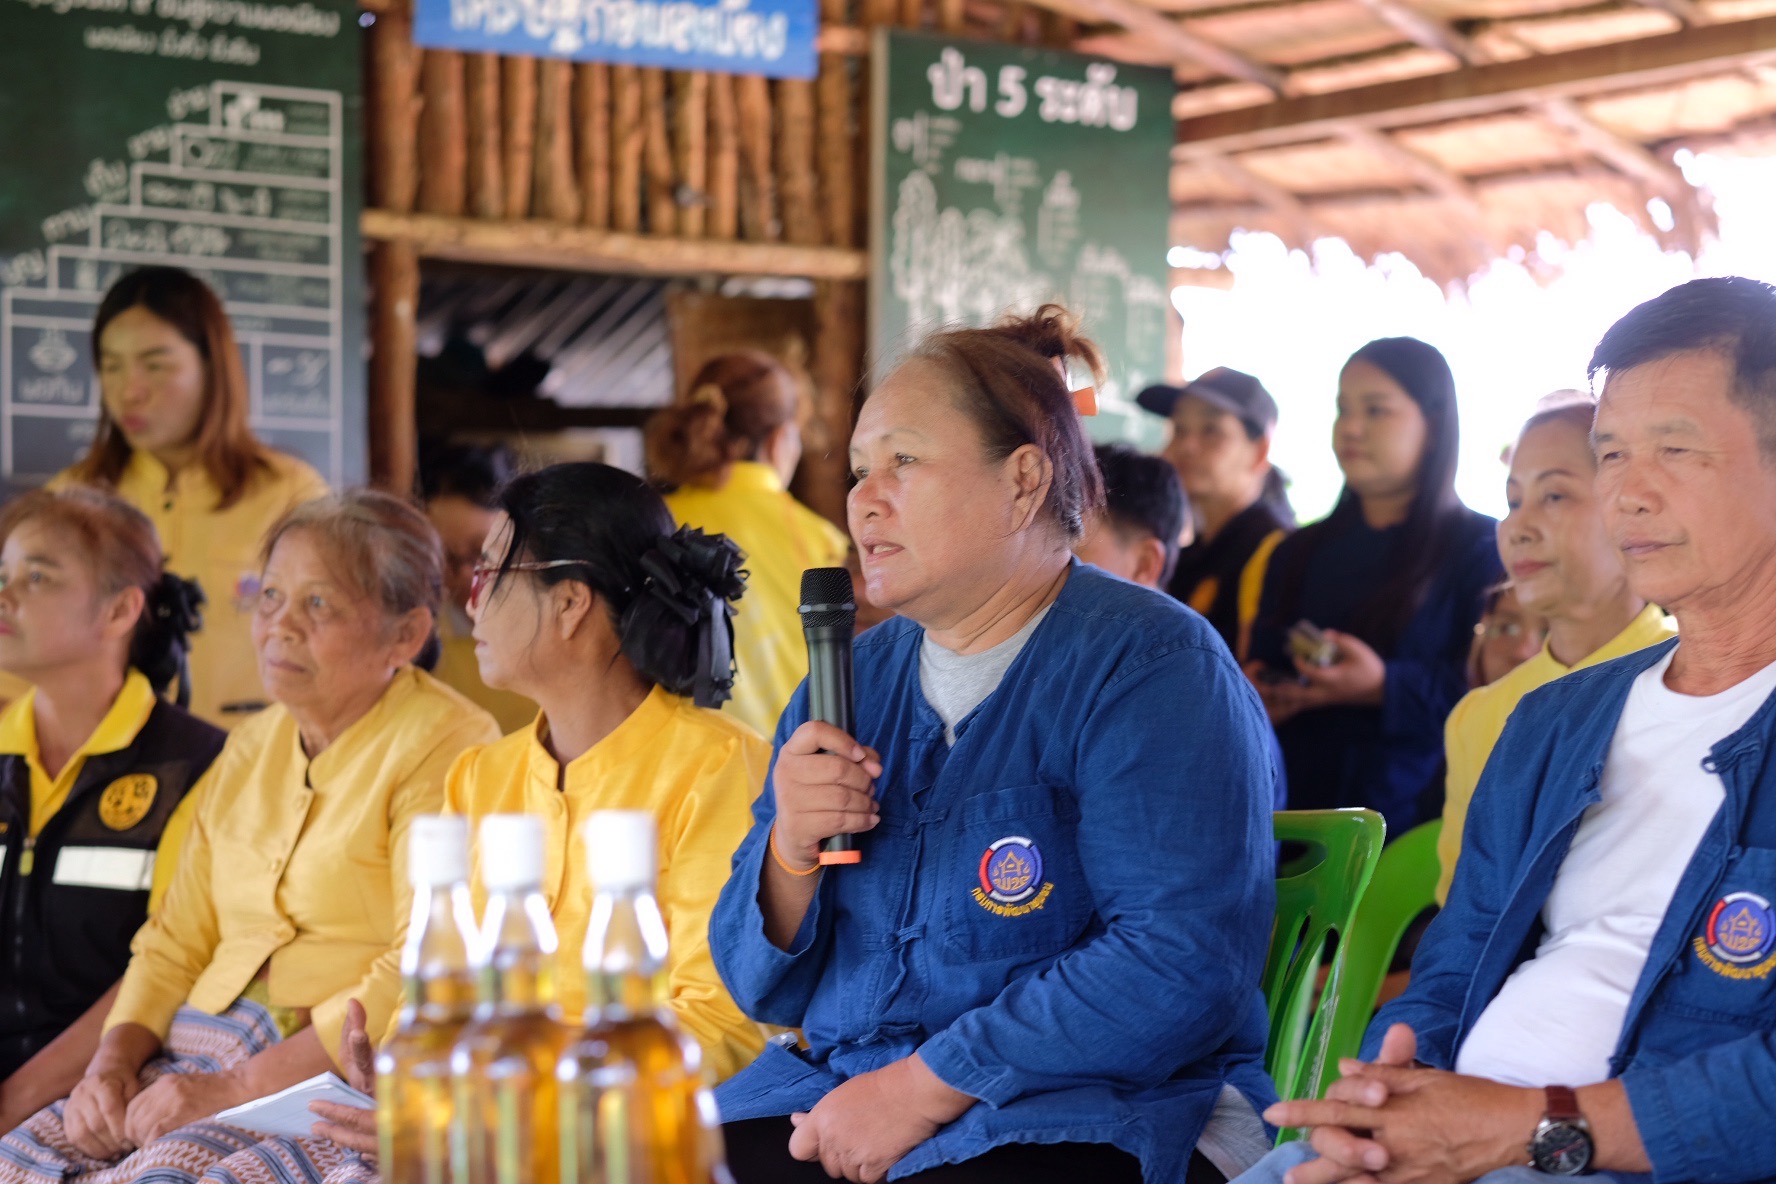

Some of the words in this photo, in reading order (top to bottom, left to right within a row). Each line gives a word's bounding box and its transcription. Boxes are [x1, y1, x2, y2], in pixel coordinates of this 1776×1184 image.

[927, 46, 988, 114] ป่า
[995, 64, 1028, 118] 5
[1034, 62, 1139, 132] ระดับ
